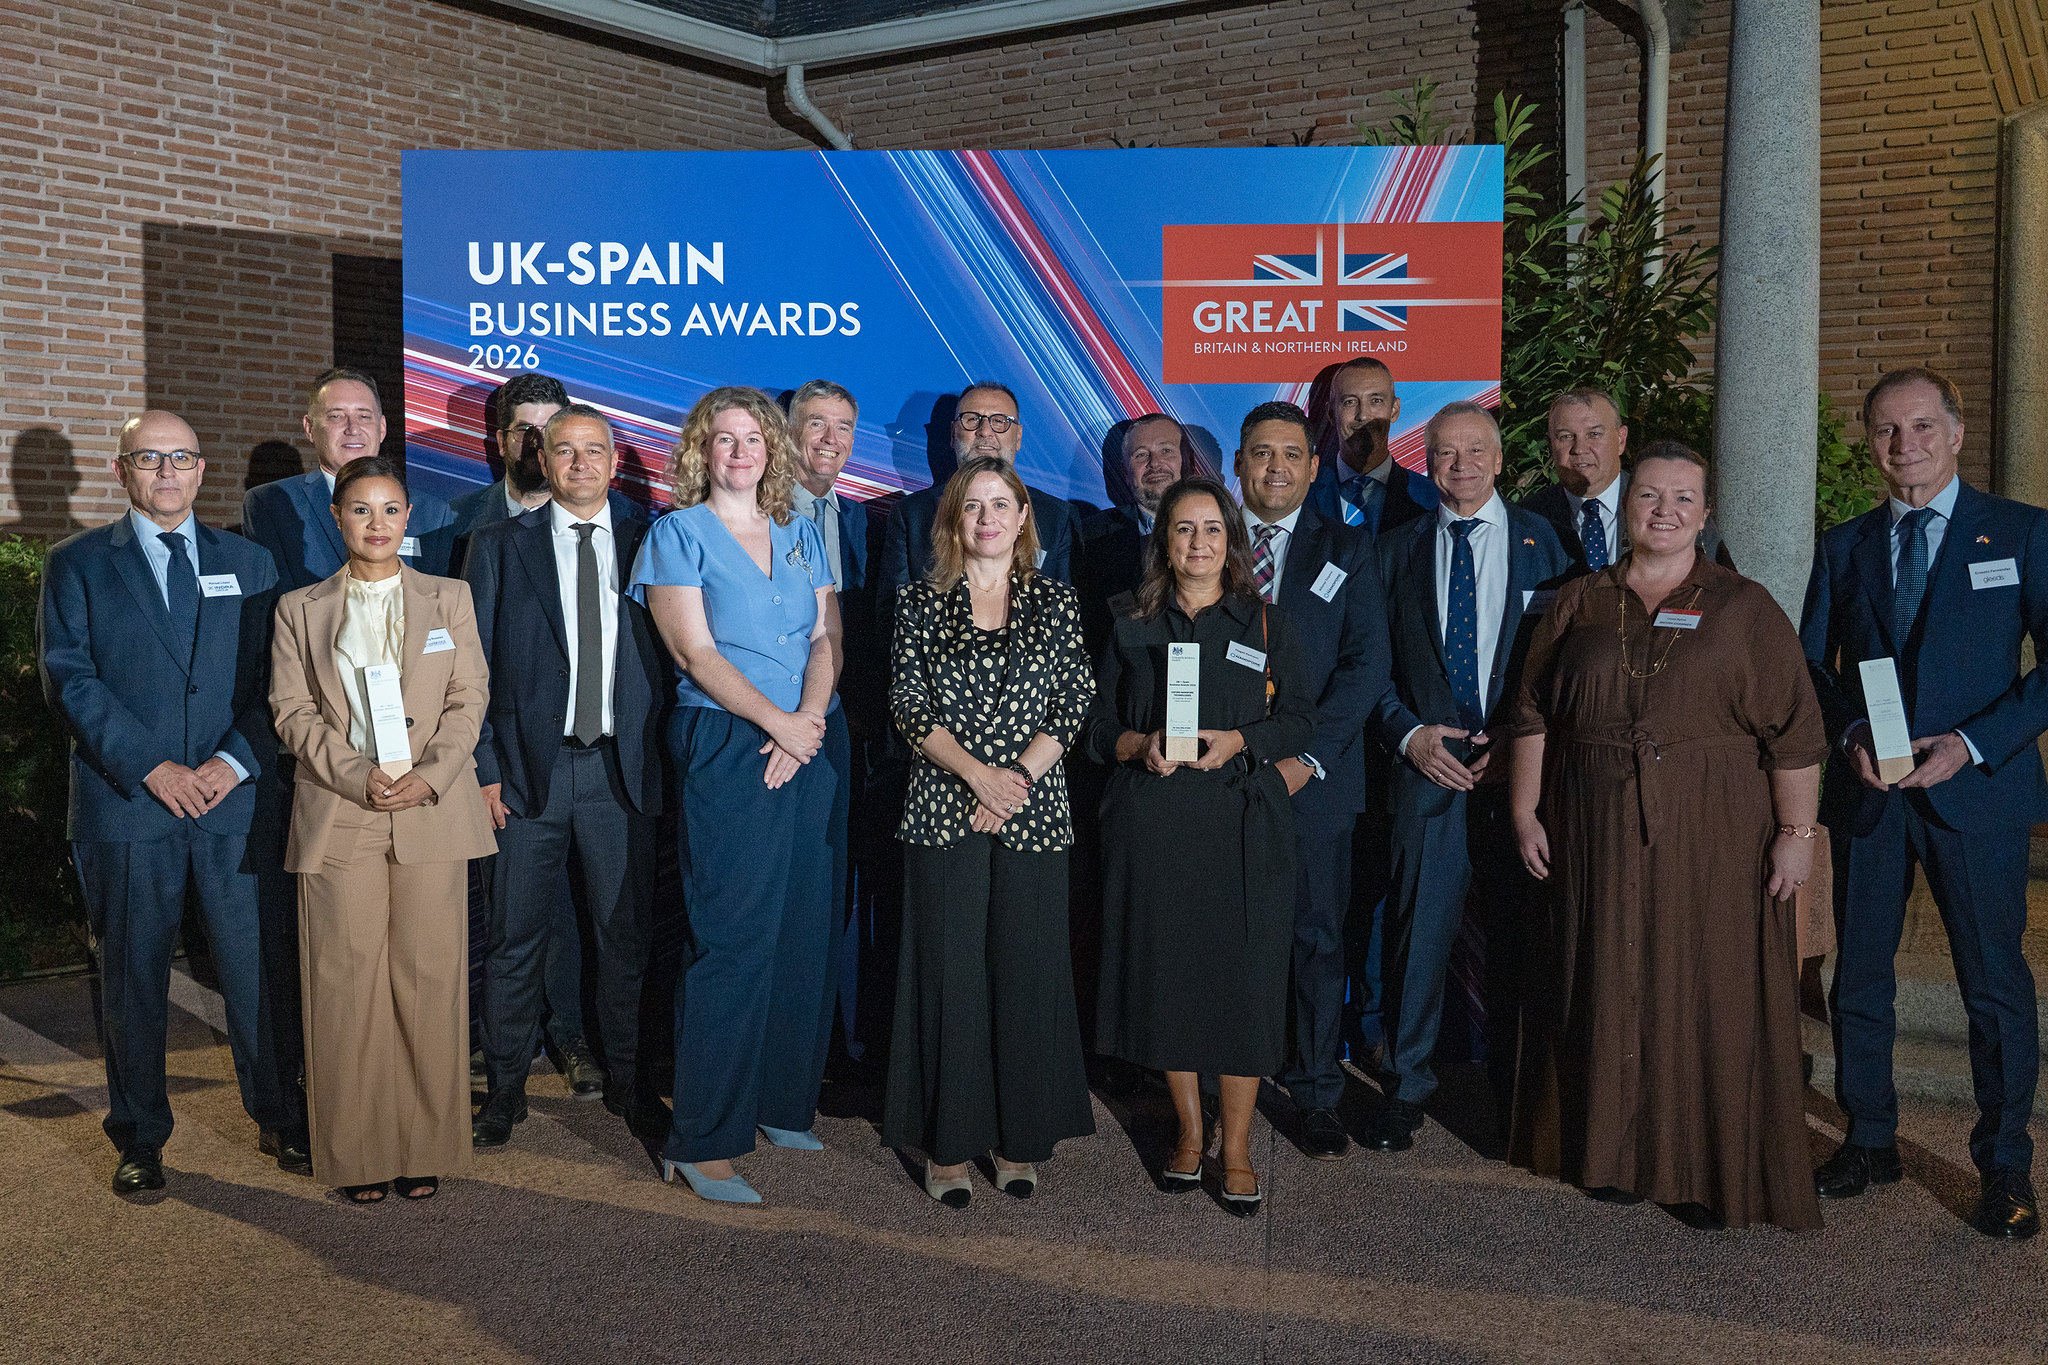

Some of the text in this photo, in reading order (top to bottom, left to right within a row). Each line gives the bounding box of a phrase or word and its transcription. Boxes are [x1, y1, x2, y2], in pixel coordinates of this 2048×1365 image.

[468, 241, 725, 286] UK-SPAIN
[469, 301, 861, 337] BUSINESS AWARDS
[1192, 300, 1323, 334] GREAT
[468, 344, 540, 370] 2026
[1194, 340, 1408, 354] BRITAIN & NORTHERN IRELAND
